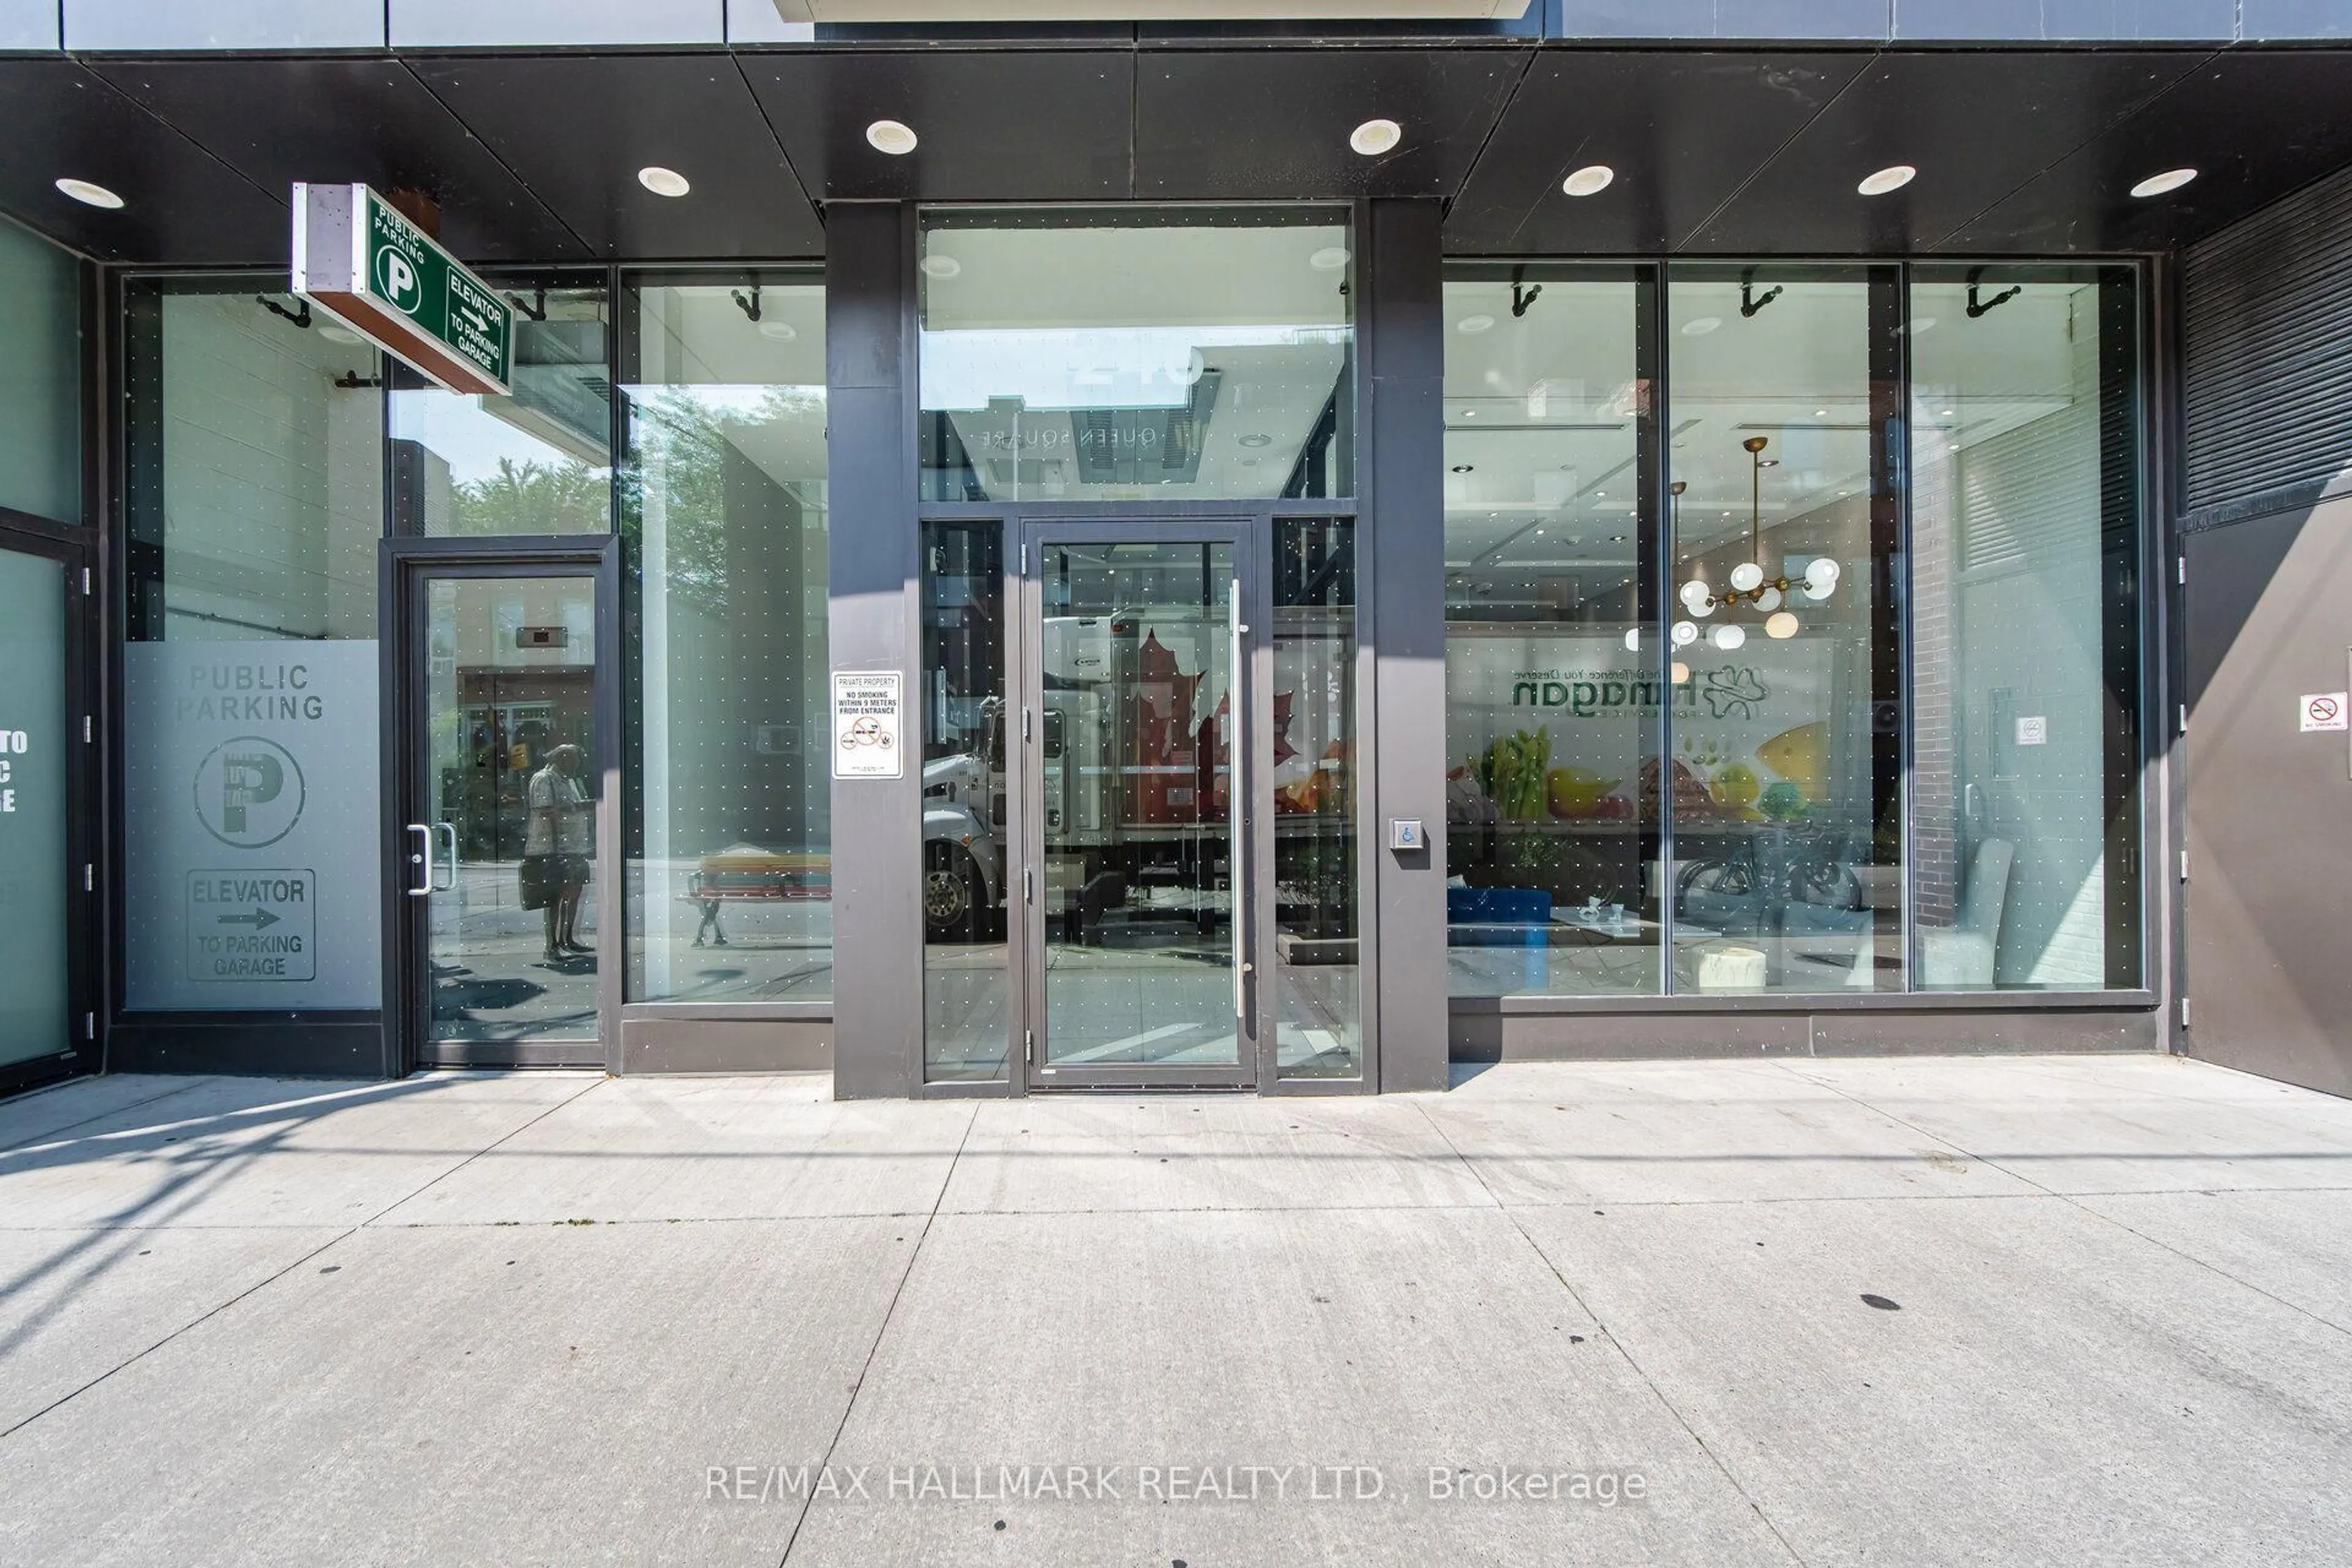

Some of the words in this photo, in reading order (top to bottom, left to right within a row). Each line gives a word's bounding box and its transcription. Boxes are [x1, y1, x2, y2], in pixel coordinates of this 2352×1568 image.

[374, 217, 425, 265] PARKING
[379, 205, 420, 247] PUBLIC
[388, 252, 413, 301] P
[450, 273, 502, 326] ELEVATOR
[451, 313, 463, 331] TO
[464, 325, 500, 360] PARKING
[458, 335, 492, 370] GARAGE
[190, 665, 309, 690] PUBLIC
[176, 696, 323, 720] PARKING
[224, 753, 284, 832] P
[193, 880, 304, 903] ELEVATOR
[198, 935, 221, 953] TO
[226, 935, 302, 954] PARKING
[214, 958, 285, 975] GARAGE
